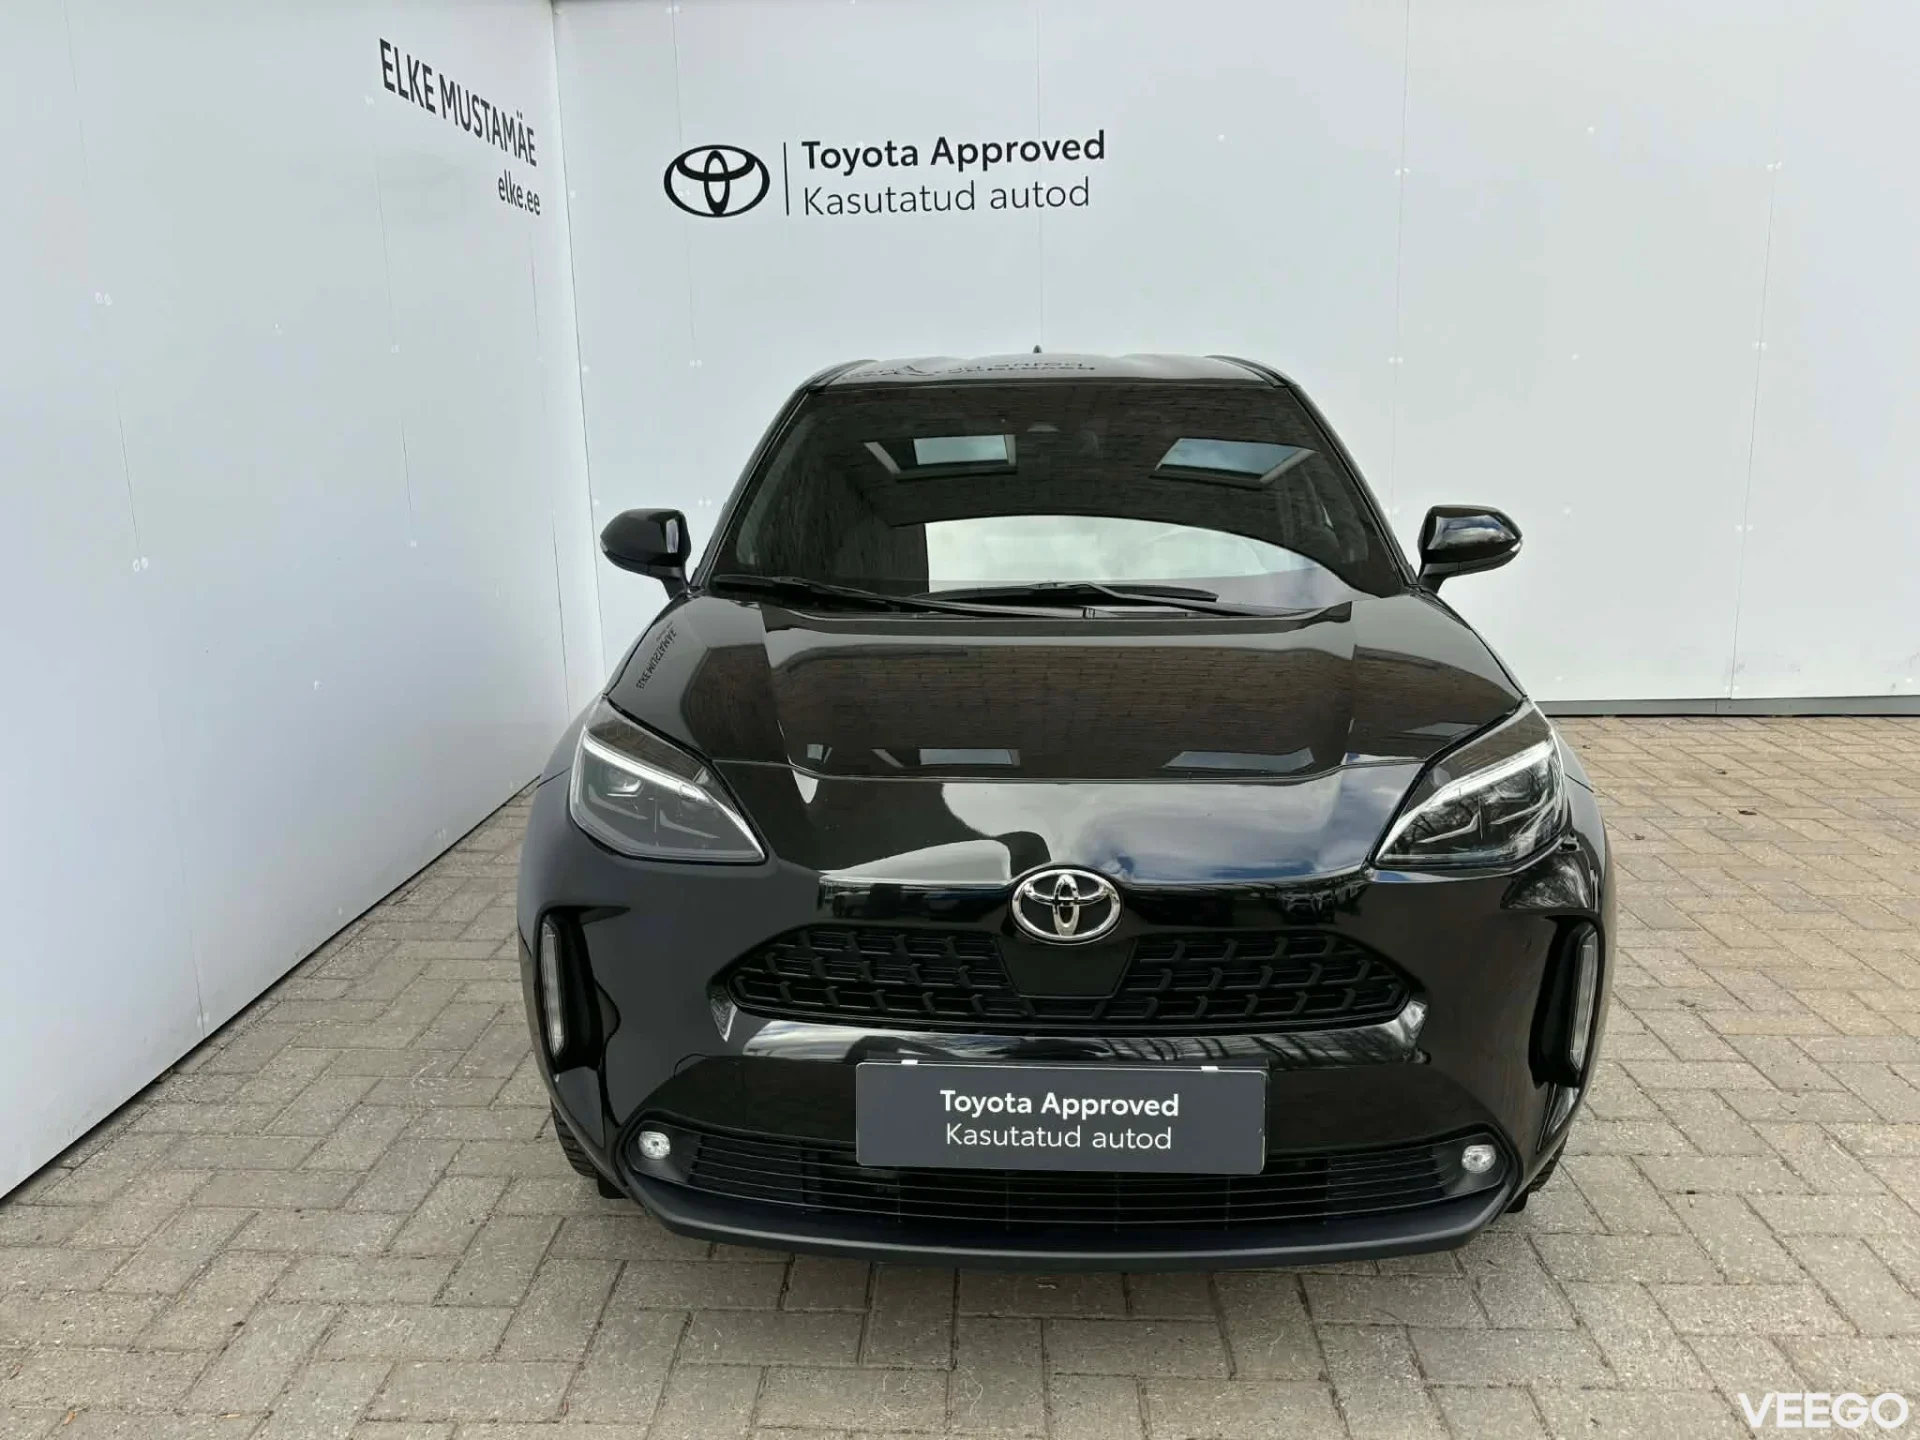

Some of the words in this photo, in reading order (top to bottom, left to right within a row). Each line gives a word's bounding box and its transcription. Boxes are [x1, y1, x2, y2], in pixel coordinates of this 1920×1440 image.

[380, 38, 436, 115] ELKE
[439, 73, 537, 167] MUSTAMÄE
[802, 140, 919, 176] Toyota
[930, 129, 1105, 173] Approved
[498, 169, 541, 216] elke.ee
[804, 180, 976, 216] Kasutatud
[989, 176, 1090, 209] autod
[939, 1089, 1032, 1118] Toyota
[1040, 1092, 1180, 1120] Approved
[946, 1123, 1081, 1147] Kasutatud
[1092, 1127, 1172, 1150] autod
